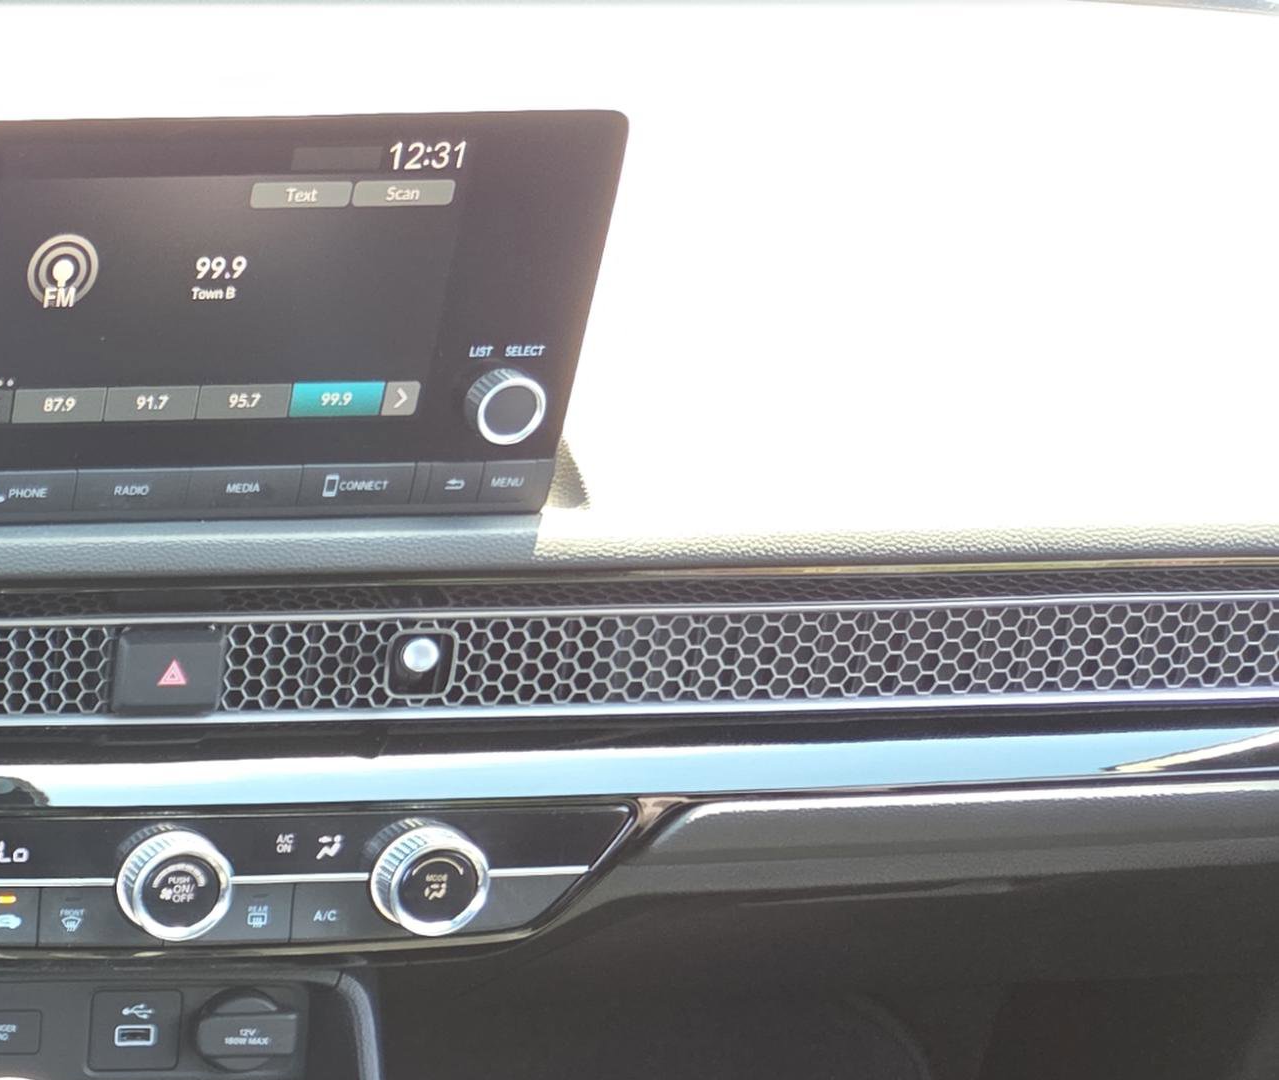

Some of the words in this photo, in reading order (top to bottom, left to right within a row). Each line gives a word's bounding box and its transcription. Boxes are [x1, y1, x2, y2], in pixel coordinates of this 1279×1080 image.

[388, 139, 468, 171] 12:31
[285, 186, 318, 203] Text
[385, 184, 421, 202] Scan
[194, 254, 248, 280] 99.9
[42, 285, 77, 309] FM
[190, 286, 223, 301] Town
[225, 286, 237, 301] B
[468, 345, 494, 358] LIST
[504, 345, 546, 358] SELECT
[42, 396, 77, 413] 87.9
[135, 394, 170, 412] 91.7
[227, 392, 262, 410] 95.7
[320, 392, 353, 408] 99.9
[225, 481, 261, 494] MEDIA
[339, 479, 390, 492] CONNECT
[490, 475, 526, 489] MENU
[8, 487, 48, 499] PHONE
[113, 484, 151, 497] RADIO
[275, 833, 295, 844] A/C
[275, 844, 292, 854] ON
[167, 876, 191, 884] PUSH
[171, 893, 195, 903] OFF
[312, 909, 338, 922] A/C
